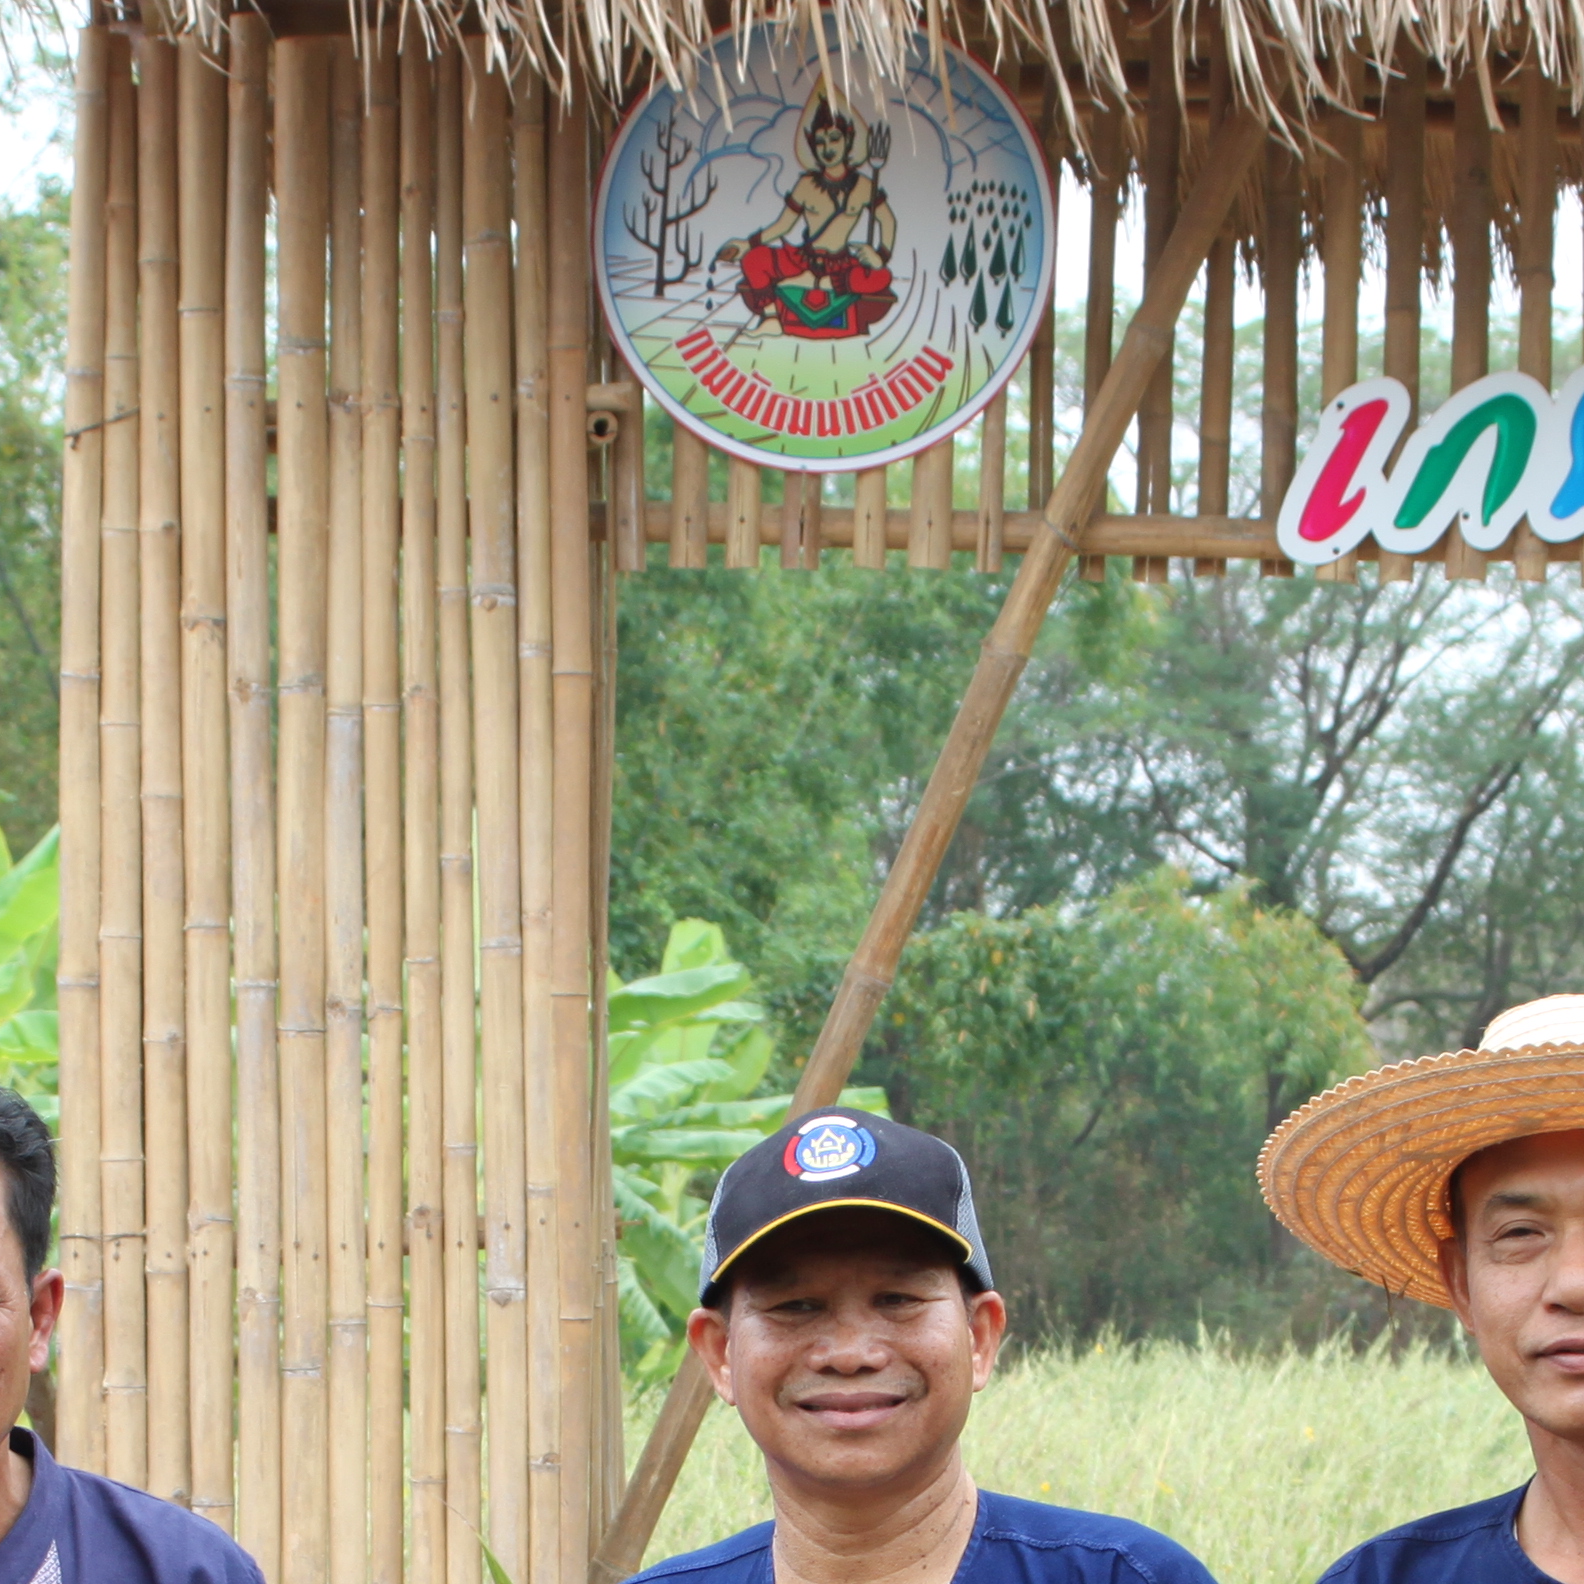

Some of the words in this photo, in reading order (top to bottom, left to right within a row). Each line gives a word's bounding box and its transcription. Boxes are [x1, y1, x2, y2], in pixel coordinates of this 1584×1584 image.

[672, 327, 955, 437] กรมพัฒนาที่ดิน
